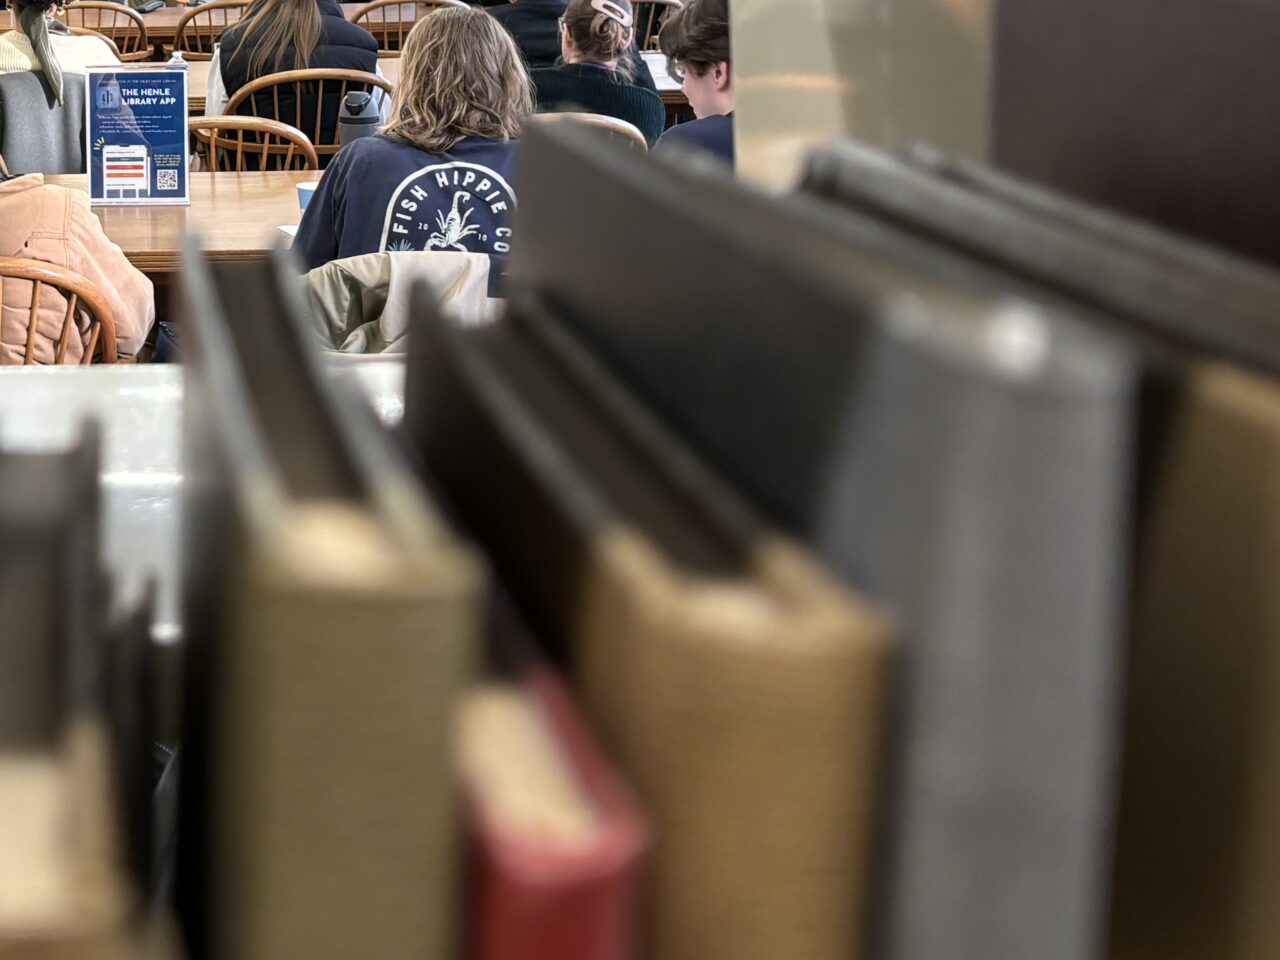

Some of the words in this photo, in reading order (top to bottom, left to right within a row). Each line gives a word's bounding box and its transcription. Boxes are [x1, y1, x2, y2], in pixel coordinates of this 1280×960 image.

[122, 88, 138, 96] THE
[141, 88, 170, 96] HENLE
[121, 97, 158, 105] LIBRARY
[159, 97, 176, 105] APP
[392, 184, 428, 234] FISH
[435, 170, 508, 214] HIPPIE
[493, 227, 512, 253] CO
[418, 222, 429, 231] 20
[478, 233, 488, 242] 10
